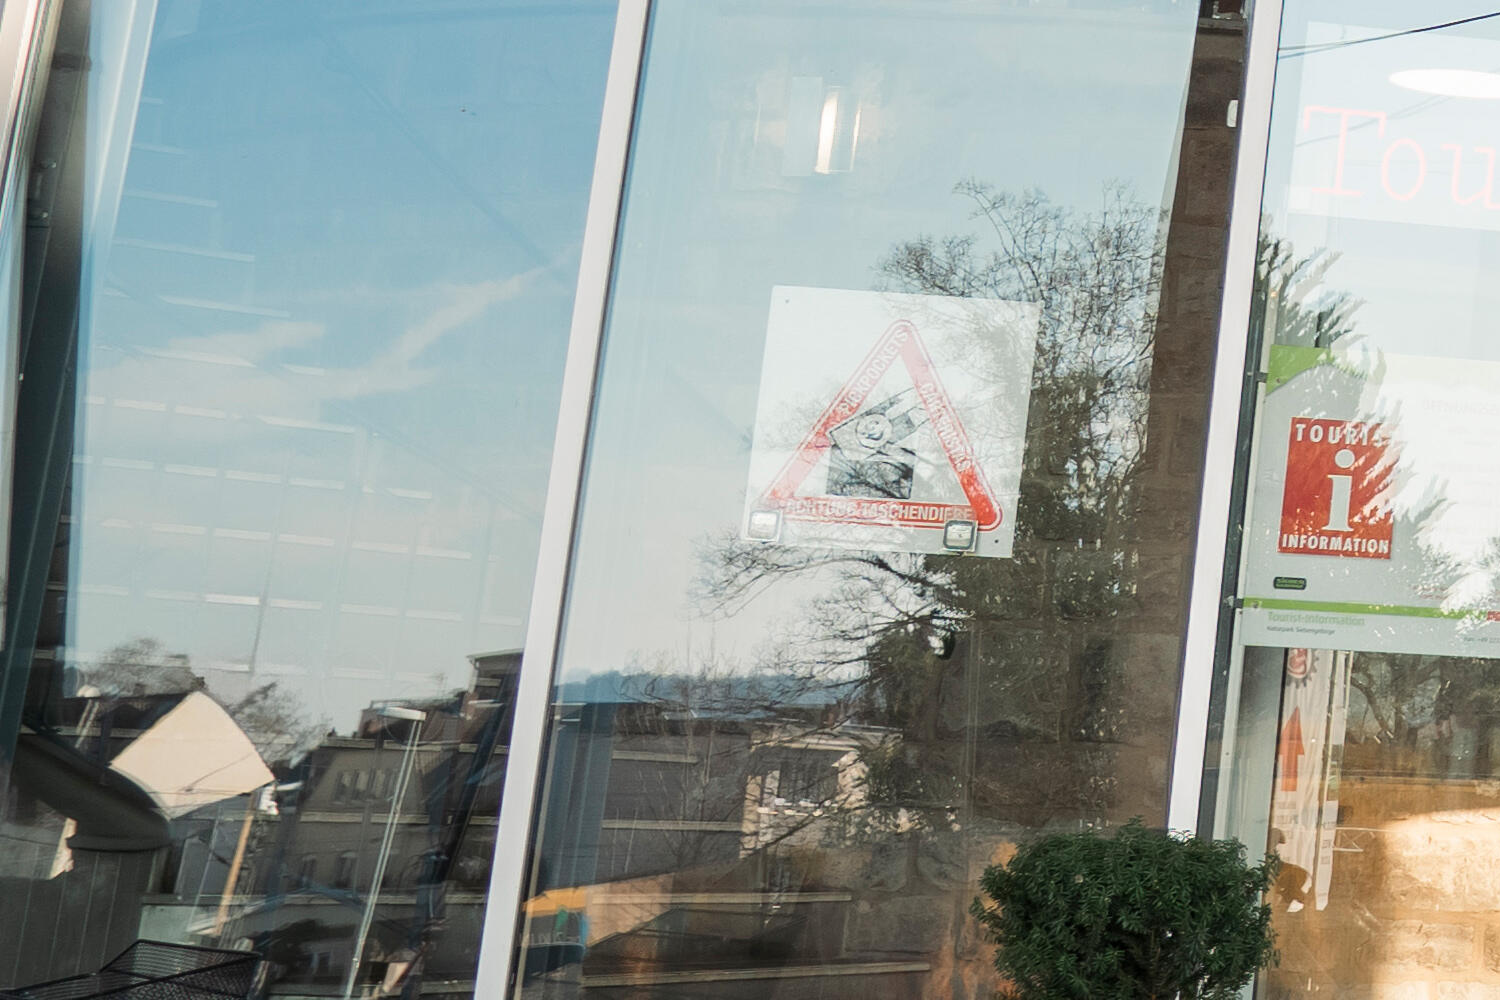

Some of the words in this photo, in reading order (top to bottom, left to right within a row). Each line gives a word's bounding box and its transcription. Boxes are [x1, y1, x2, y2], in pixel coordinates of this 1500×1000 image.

[837, 329, 909, 416] PICKPOCKETS
[1296, 423, 1391, 448] TOURIS
[1282, 533, 1390, 554] INFORMATION
